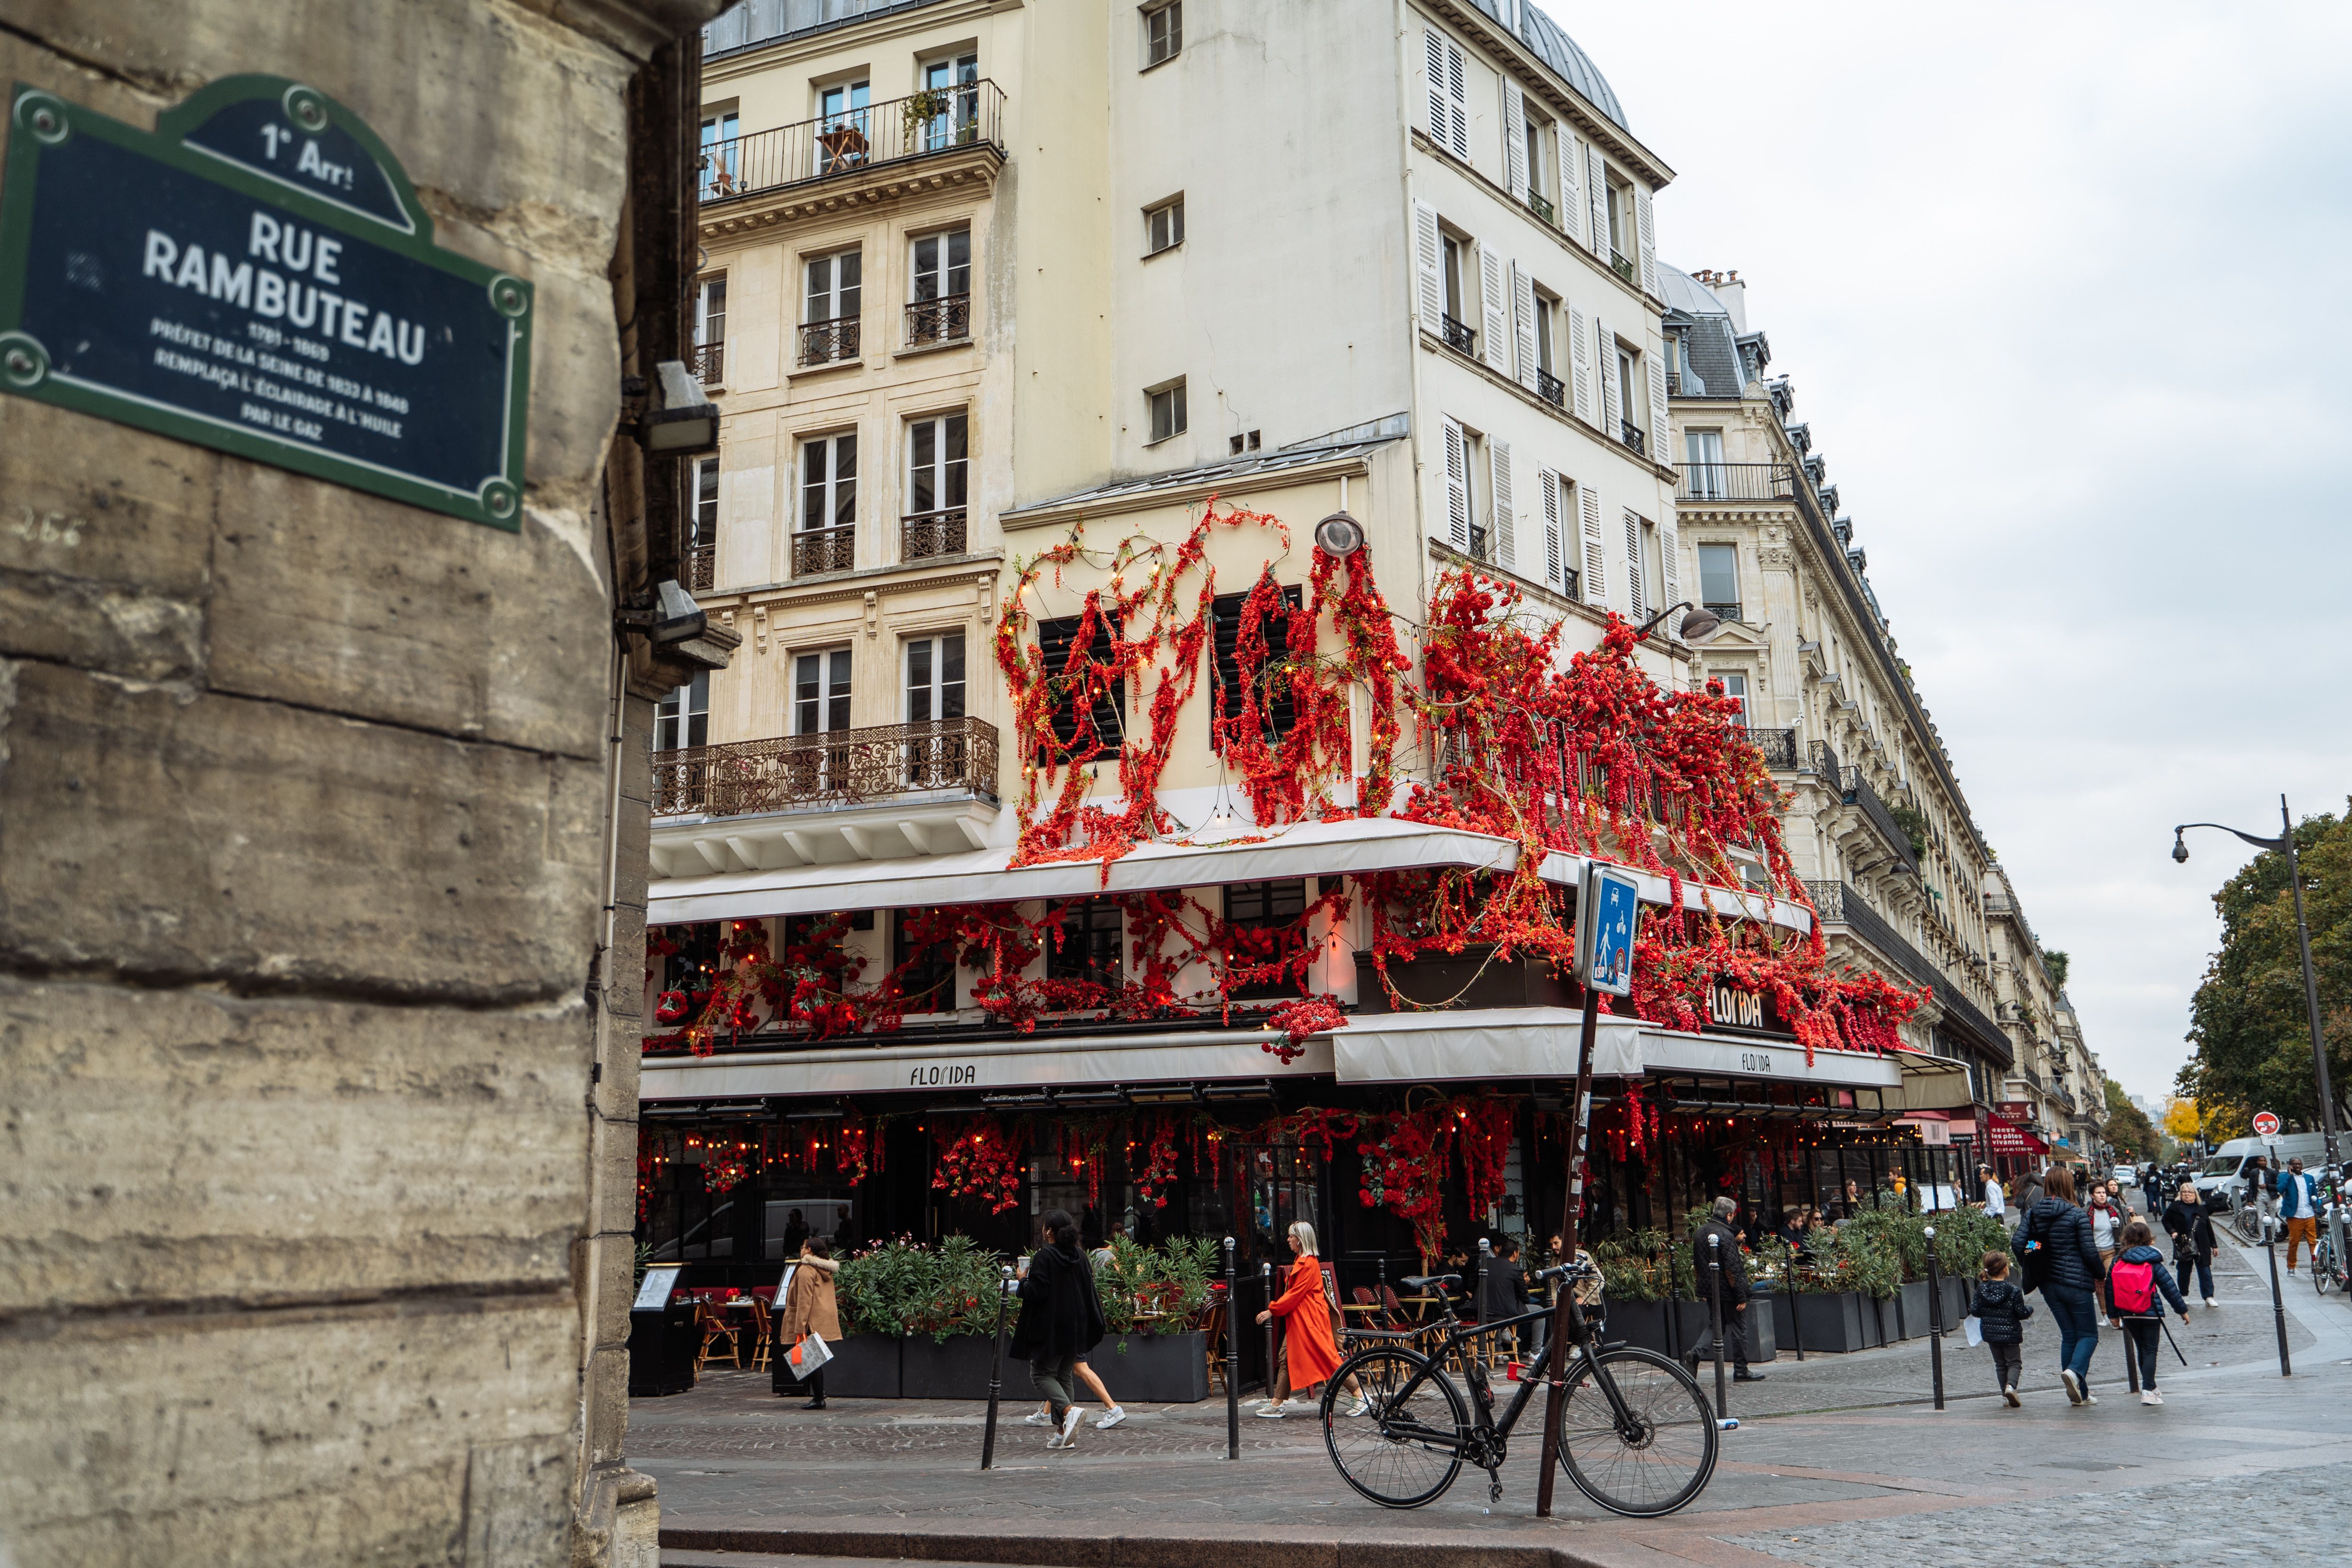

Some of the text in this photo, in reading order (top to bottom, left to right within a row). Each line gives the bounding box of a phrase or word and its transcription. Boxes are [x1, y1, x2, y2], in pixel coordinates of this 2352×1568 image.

[248, 211, 343, 286] RUE
[143, 228, 426, 366] RAMBUTEAU
[151, 318, 212, 351] PRÉFET
[212, 337, 235, 360] DE
[236, 344, 256, 366] LA
[257, 352, 302, 382] SEINE
[303, 367, 325, 388] DE
[154, 347, 238, 391] REMPLAÇA
[241, 402, 323, 441] PAR LE GAZ
[910, 1065, 975, 1086] FLORIDA
[1742, 1053, 1771, 1072] FLORIDA
